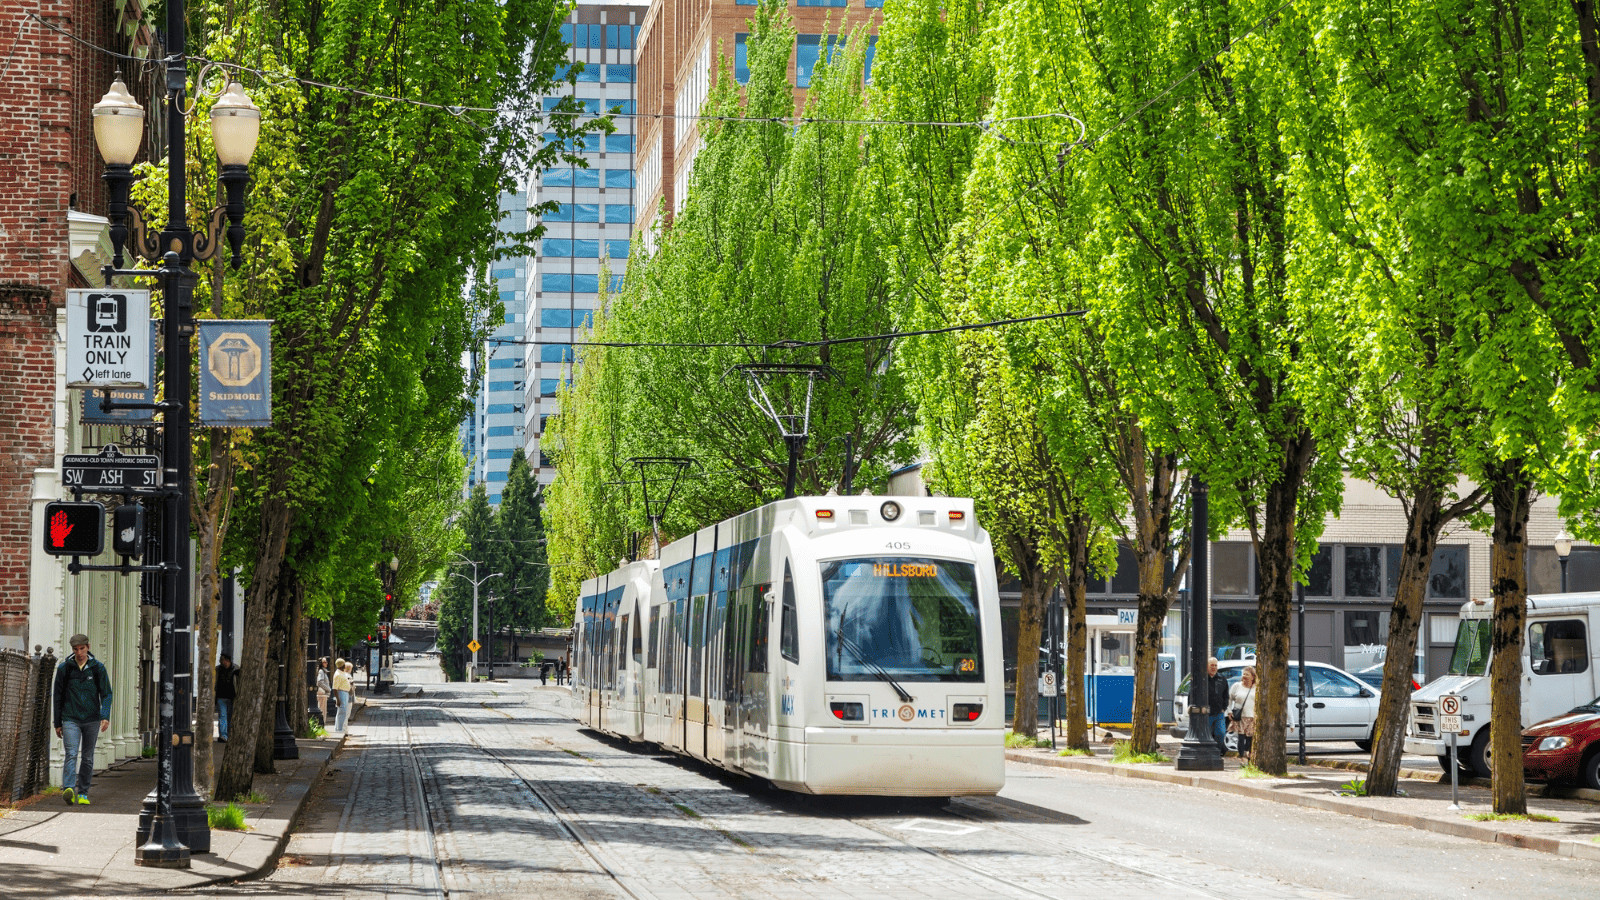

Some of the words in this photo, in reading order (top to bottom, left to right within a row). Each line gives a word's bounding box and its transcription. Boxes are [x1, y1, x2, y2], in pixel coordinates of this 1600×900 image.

[84, 335, 131, 348] TRAIN
[86, 351, 127, 364] ONLY
[95, 369, 110, 379] left
[112, 369, 132, 379] lane
[209, 391, 262, 401] SKIDMORE
[65, 469, 84, 484] SW
[99, 470, 123, 484] ASH
[143, 470, 156, 485] ST
[885, 541, 911, 550] 405
[873, 563, 939, 578] HILLSBORO
[1120, 611, 1135, 623] PAY
[961, 658, 975, 672] 20
[781, 694, 795, 716] MAX
[872, 709, 895, 718] TRI
[917, 709, 945, 718] MET
[1445, 716, 1458, 724] THIS
